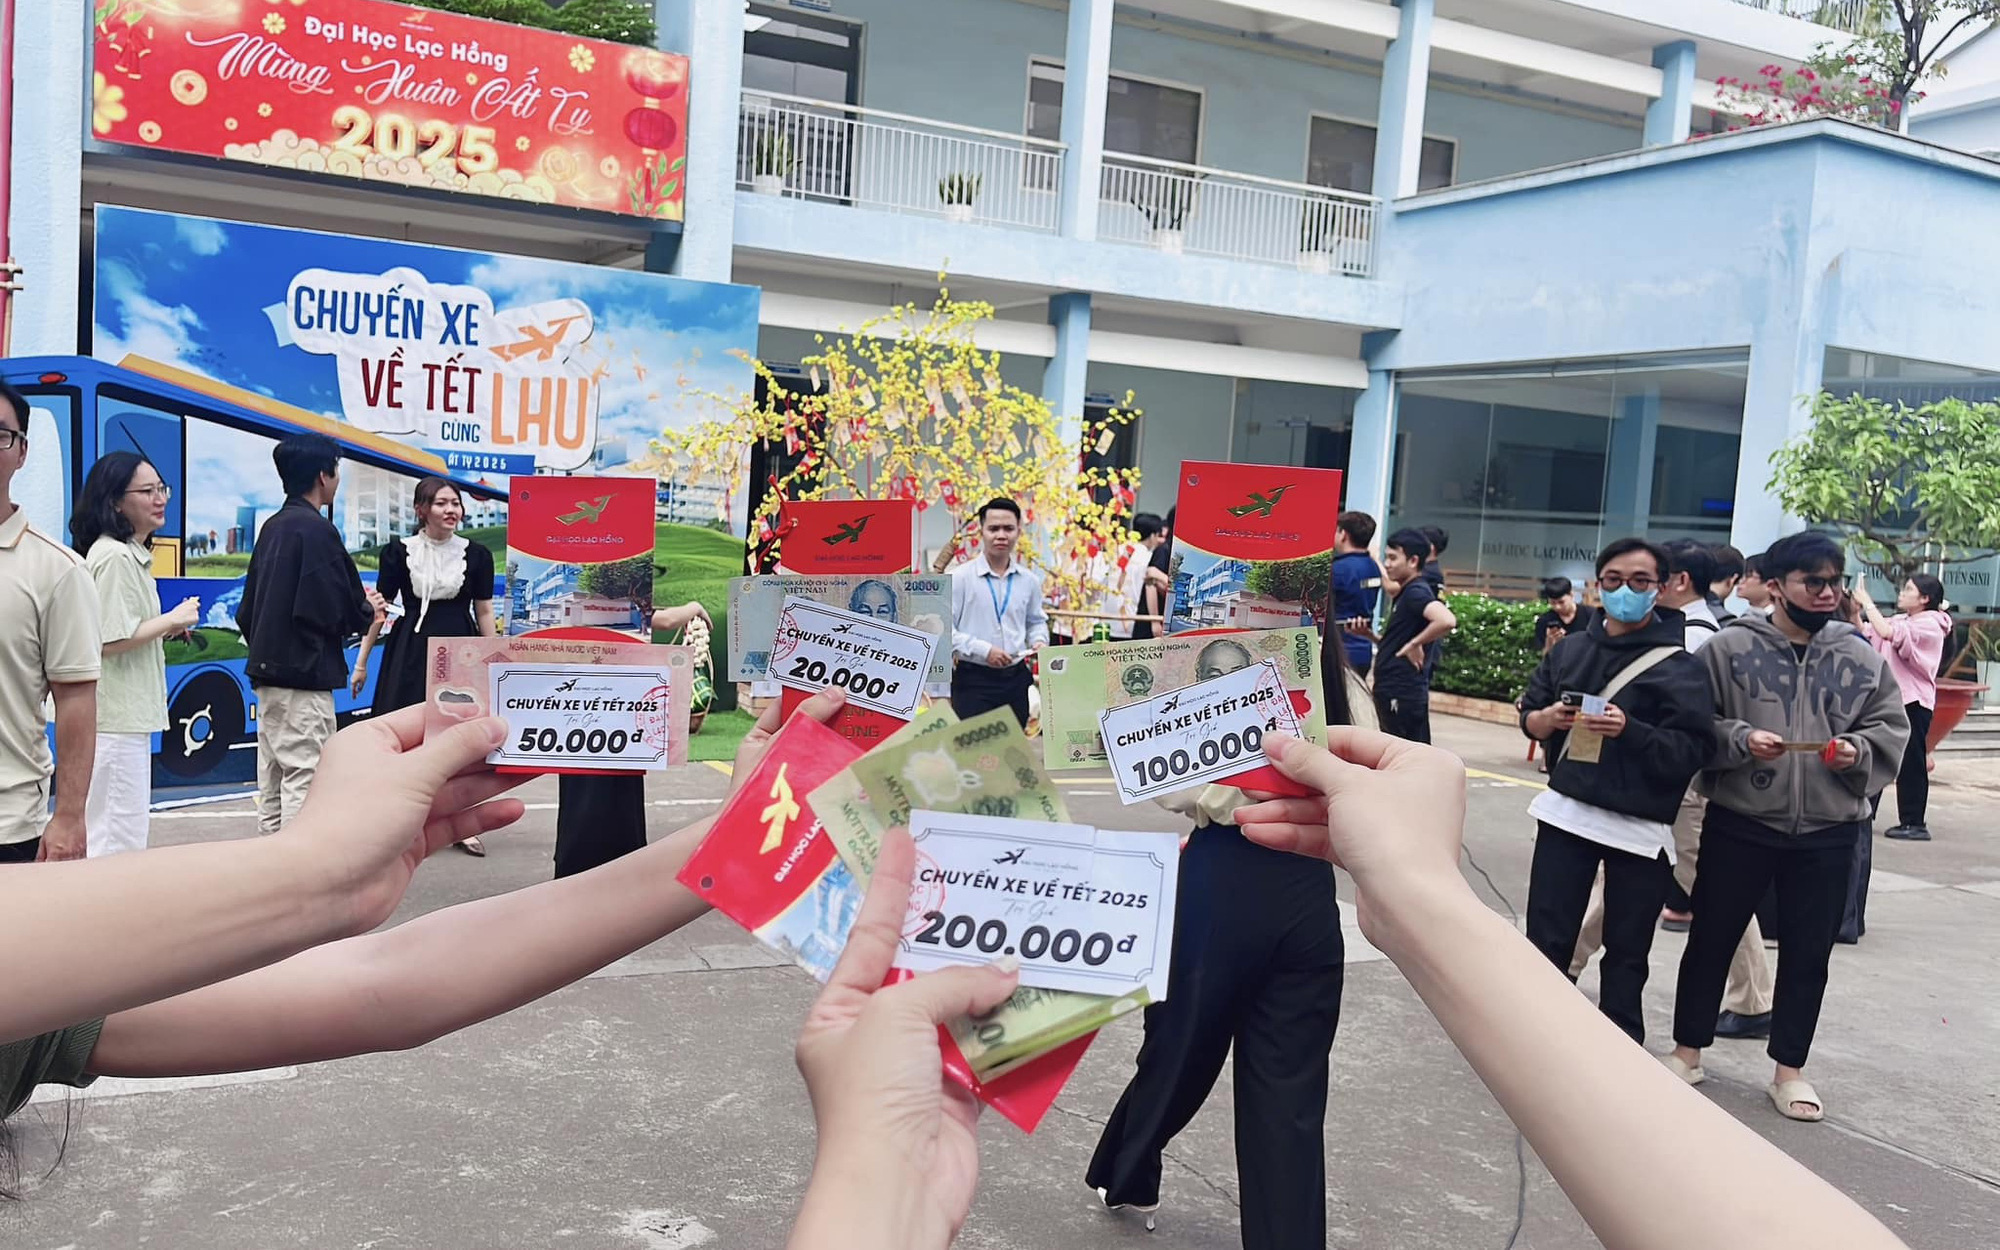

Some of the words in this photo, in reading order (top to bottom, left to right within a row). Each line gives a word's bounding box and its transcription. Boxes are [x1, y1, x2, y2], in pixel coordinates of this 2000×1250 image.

[305, 16, 344, 43] Đại
[352, 25, 397, 51] Học
[405, 34, 444, 59] Lạc
[451, 41, 508, 72] Hồng
[185, 31, 334, 94] Mừng
[341, 58, 461, 107] Xuân
[470, 67, 542, 123] Ất
[331, 105, 499, 174] 2025
[294, 284, 425, 340] CHUYẾN
[440, 302, 479, 347] XE
[361, 346, 404, 408] VỀ
[422, 353, 482, 414] TẾT
[491, 373, 589, 450] LHU
[441, 418, 480, 443] CÙNG
[905, 581, 939, 591] 20000
[787, 628, 835, 648] CHUYẾN
[835, 640, 852, 652] XE
[869, 648, 890, 662] TẾT
[889, 655, 918, 671] 2025
[788, 656, 900, 699] 20.000đ
[506, 695, 560, 710] CHUYẾN
[563, 700, 579, 711] XE
[603, 697, 625, 711] TẾT
[626, 701, 658, 712] 2025
[1117, 719, 1171, 746] CHUYẾN
[1175, 715, 1192, 730] XE
[1214, 696, 1237, 716] TẾT
[1241, 687, 1274, 708] 2025
[517, 728, 644, 754] 50.000đ
[920, 868, 999, 890] CHUYẾN
[1002, 877, 1028, 894] XE
[1062, 881, 1097, 902] TẾT
[1098, 890, 1148, 909] 2025
[915, 910, 1138, 966] 200.000đ
